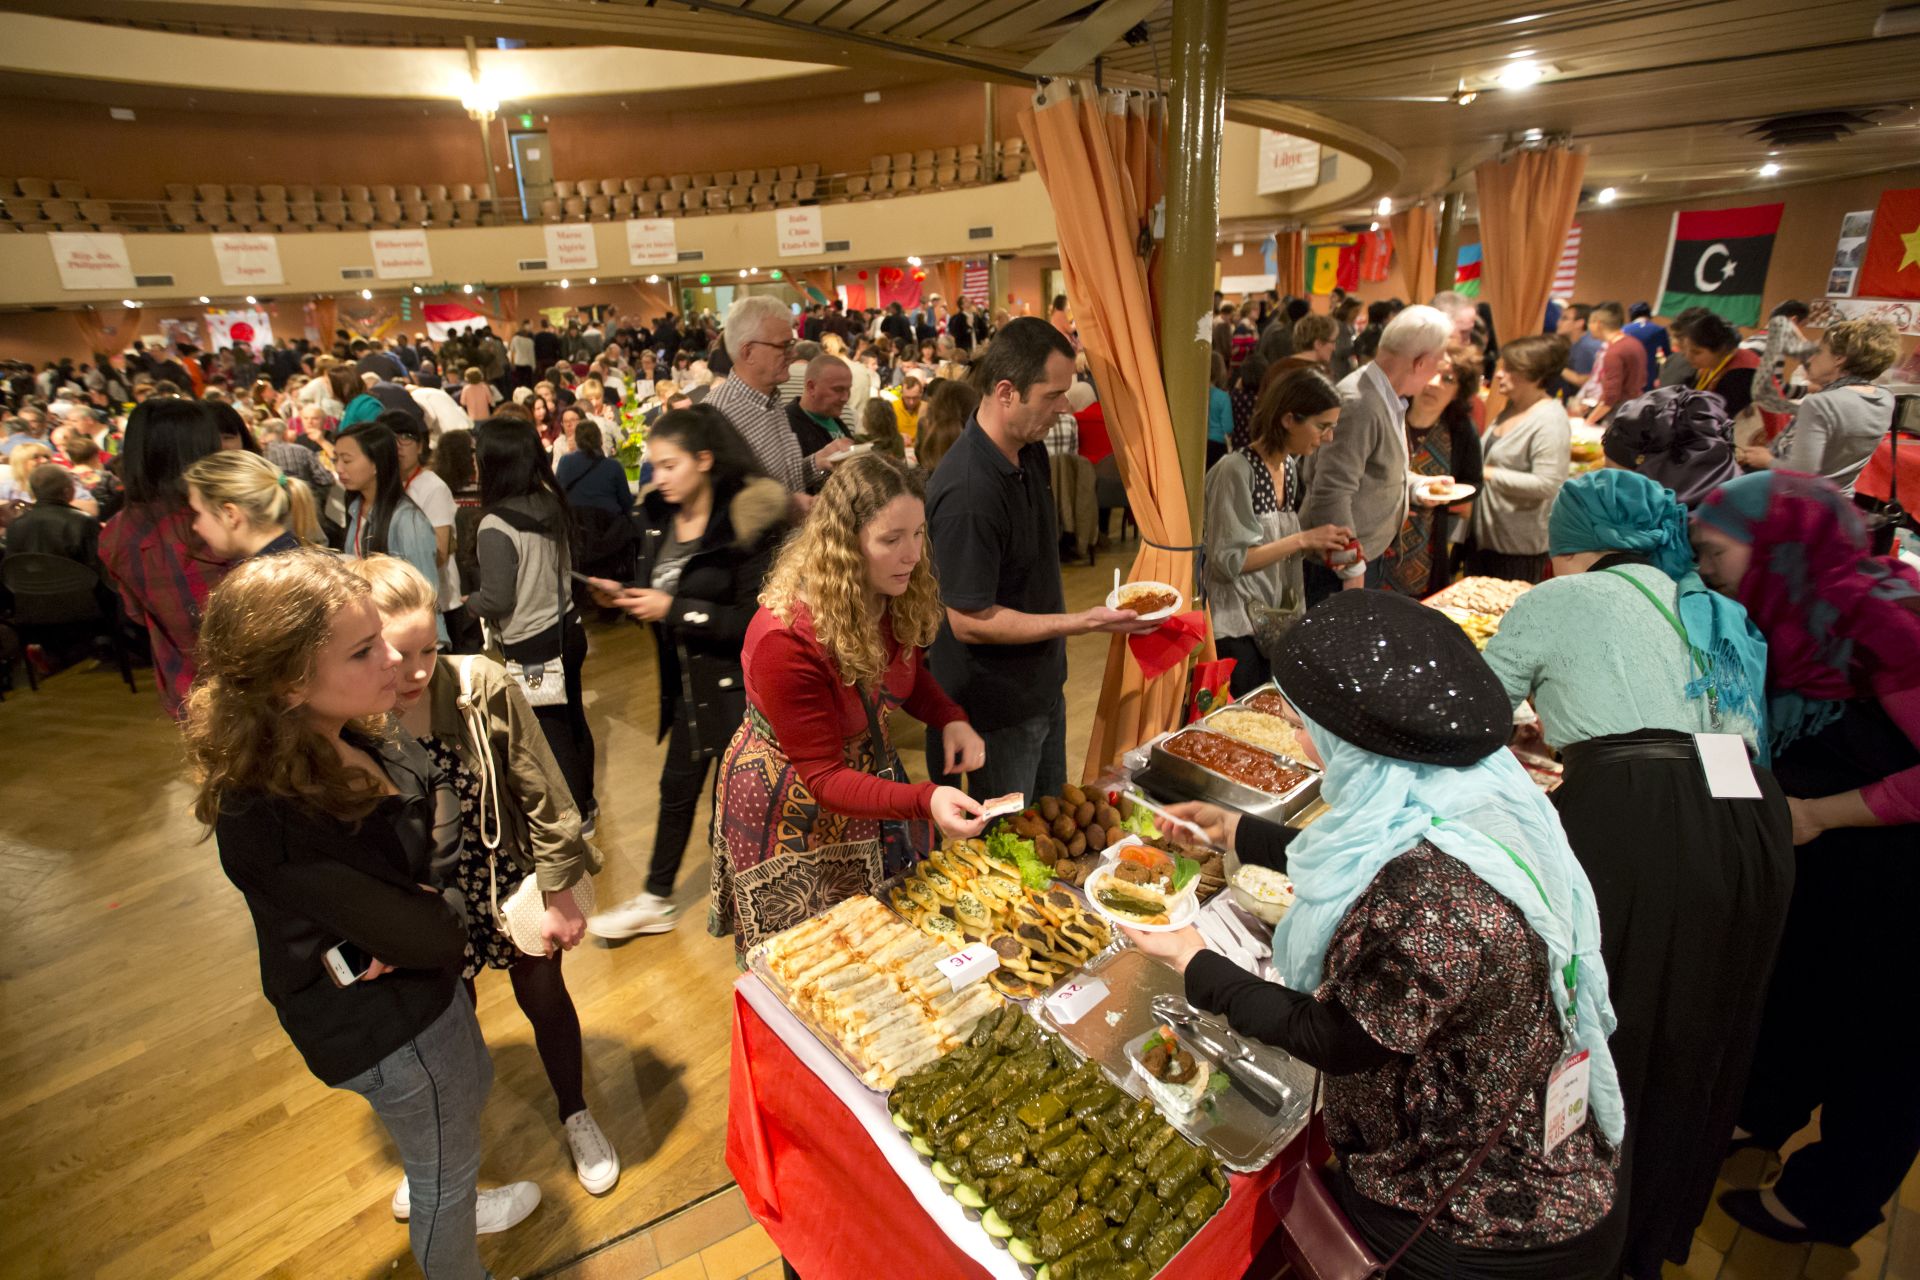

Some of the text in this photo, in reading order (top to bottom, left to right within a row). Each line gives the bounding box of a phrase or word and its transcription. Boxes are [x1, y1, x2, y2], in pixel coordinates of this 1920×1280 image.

[556, 231, 581, 239] Maroc
[788, 228, 810, 236] Chine
[950, 953, 973, 967] 1€
[1058, 984, 1083, 1000] 2€
